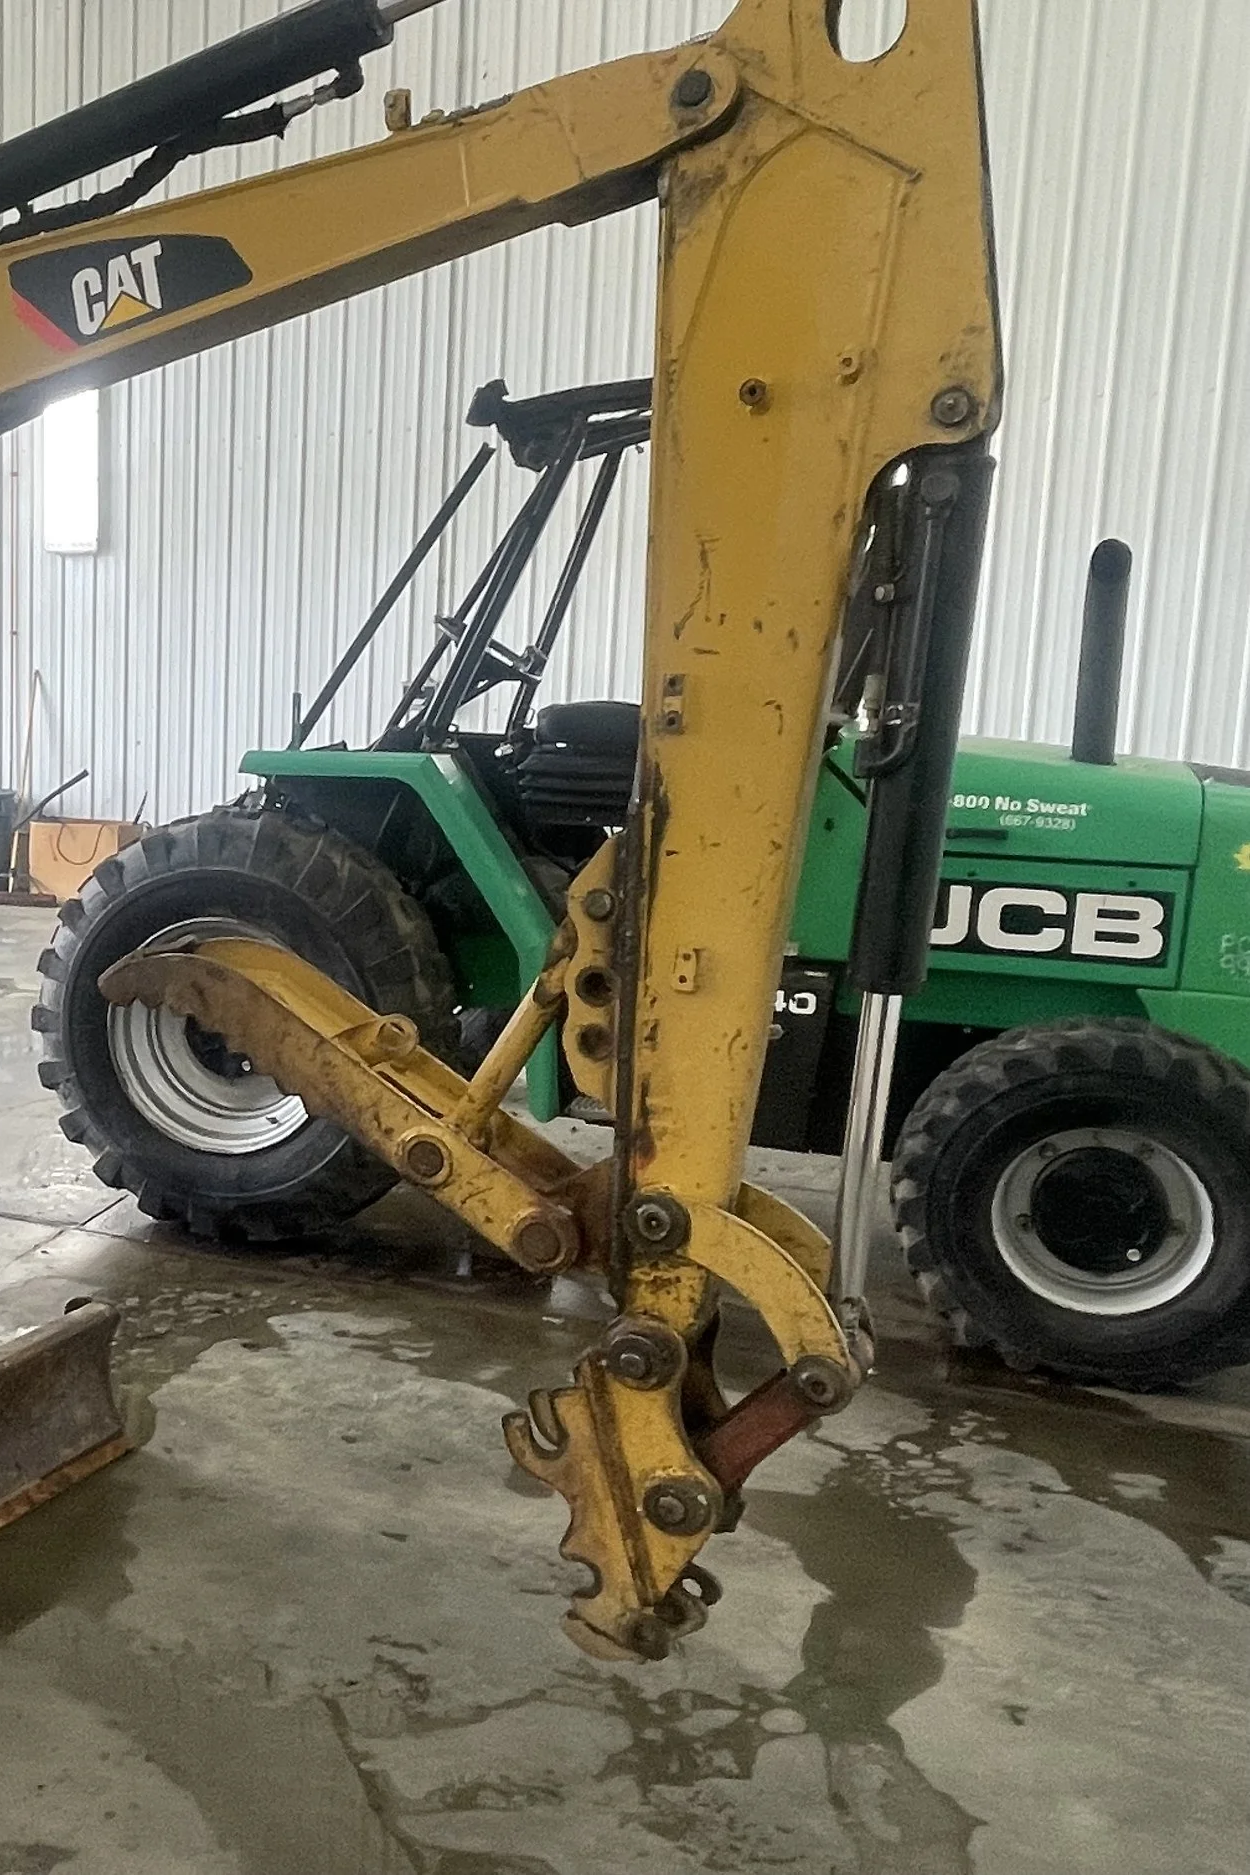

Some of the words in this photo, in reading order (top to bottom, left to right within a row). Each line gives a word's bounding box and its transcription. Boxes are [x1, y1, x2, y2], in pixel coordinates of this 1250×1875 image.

[71, 240, 163, 336] CAT
[994, 796, 1022, 811] No
[1026, 798, 1088, 816] Sweat
[929, 884, 1165, 960] JCB
